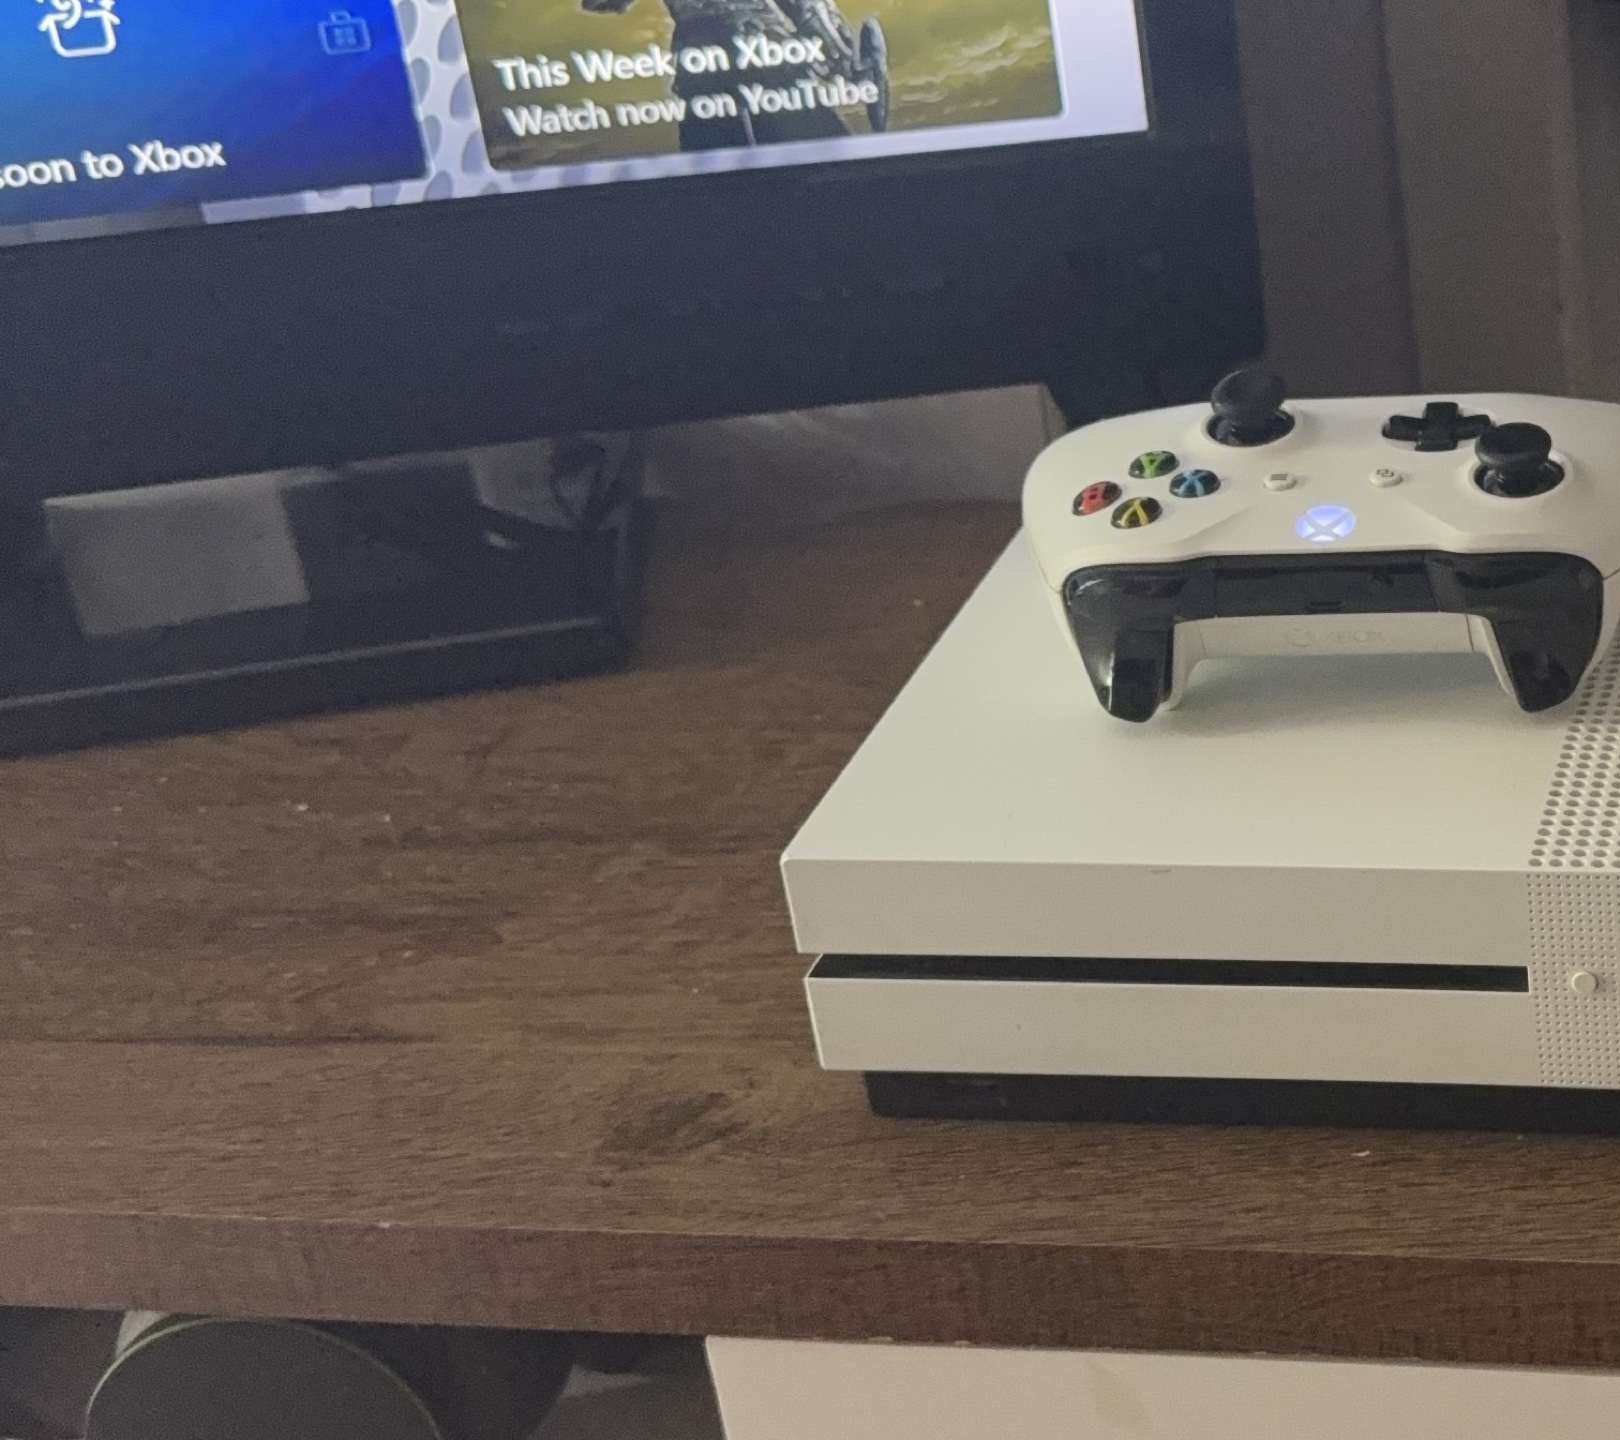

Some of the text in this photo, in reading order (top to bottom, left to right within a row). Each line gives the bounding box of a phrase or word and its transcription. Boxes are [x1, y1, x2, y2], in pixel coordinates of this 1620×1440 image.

[493, 34, 826, 92] This Week on Xbox
[504, 76, 879, 137] Watch now on YouTube
[0, 138, 228, 190] oon to Xbox
